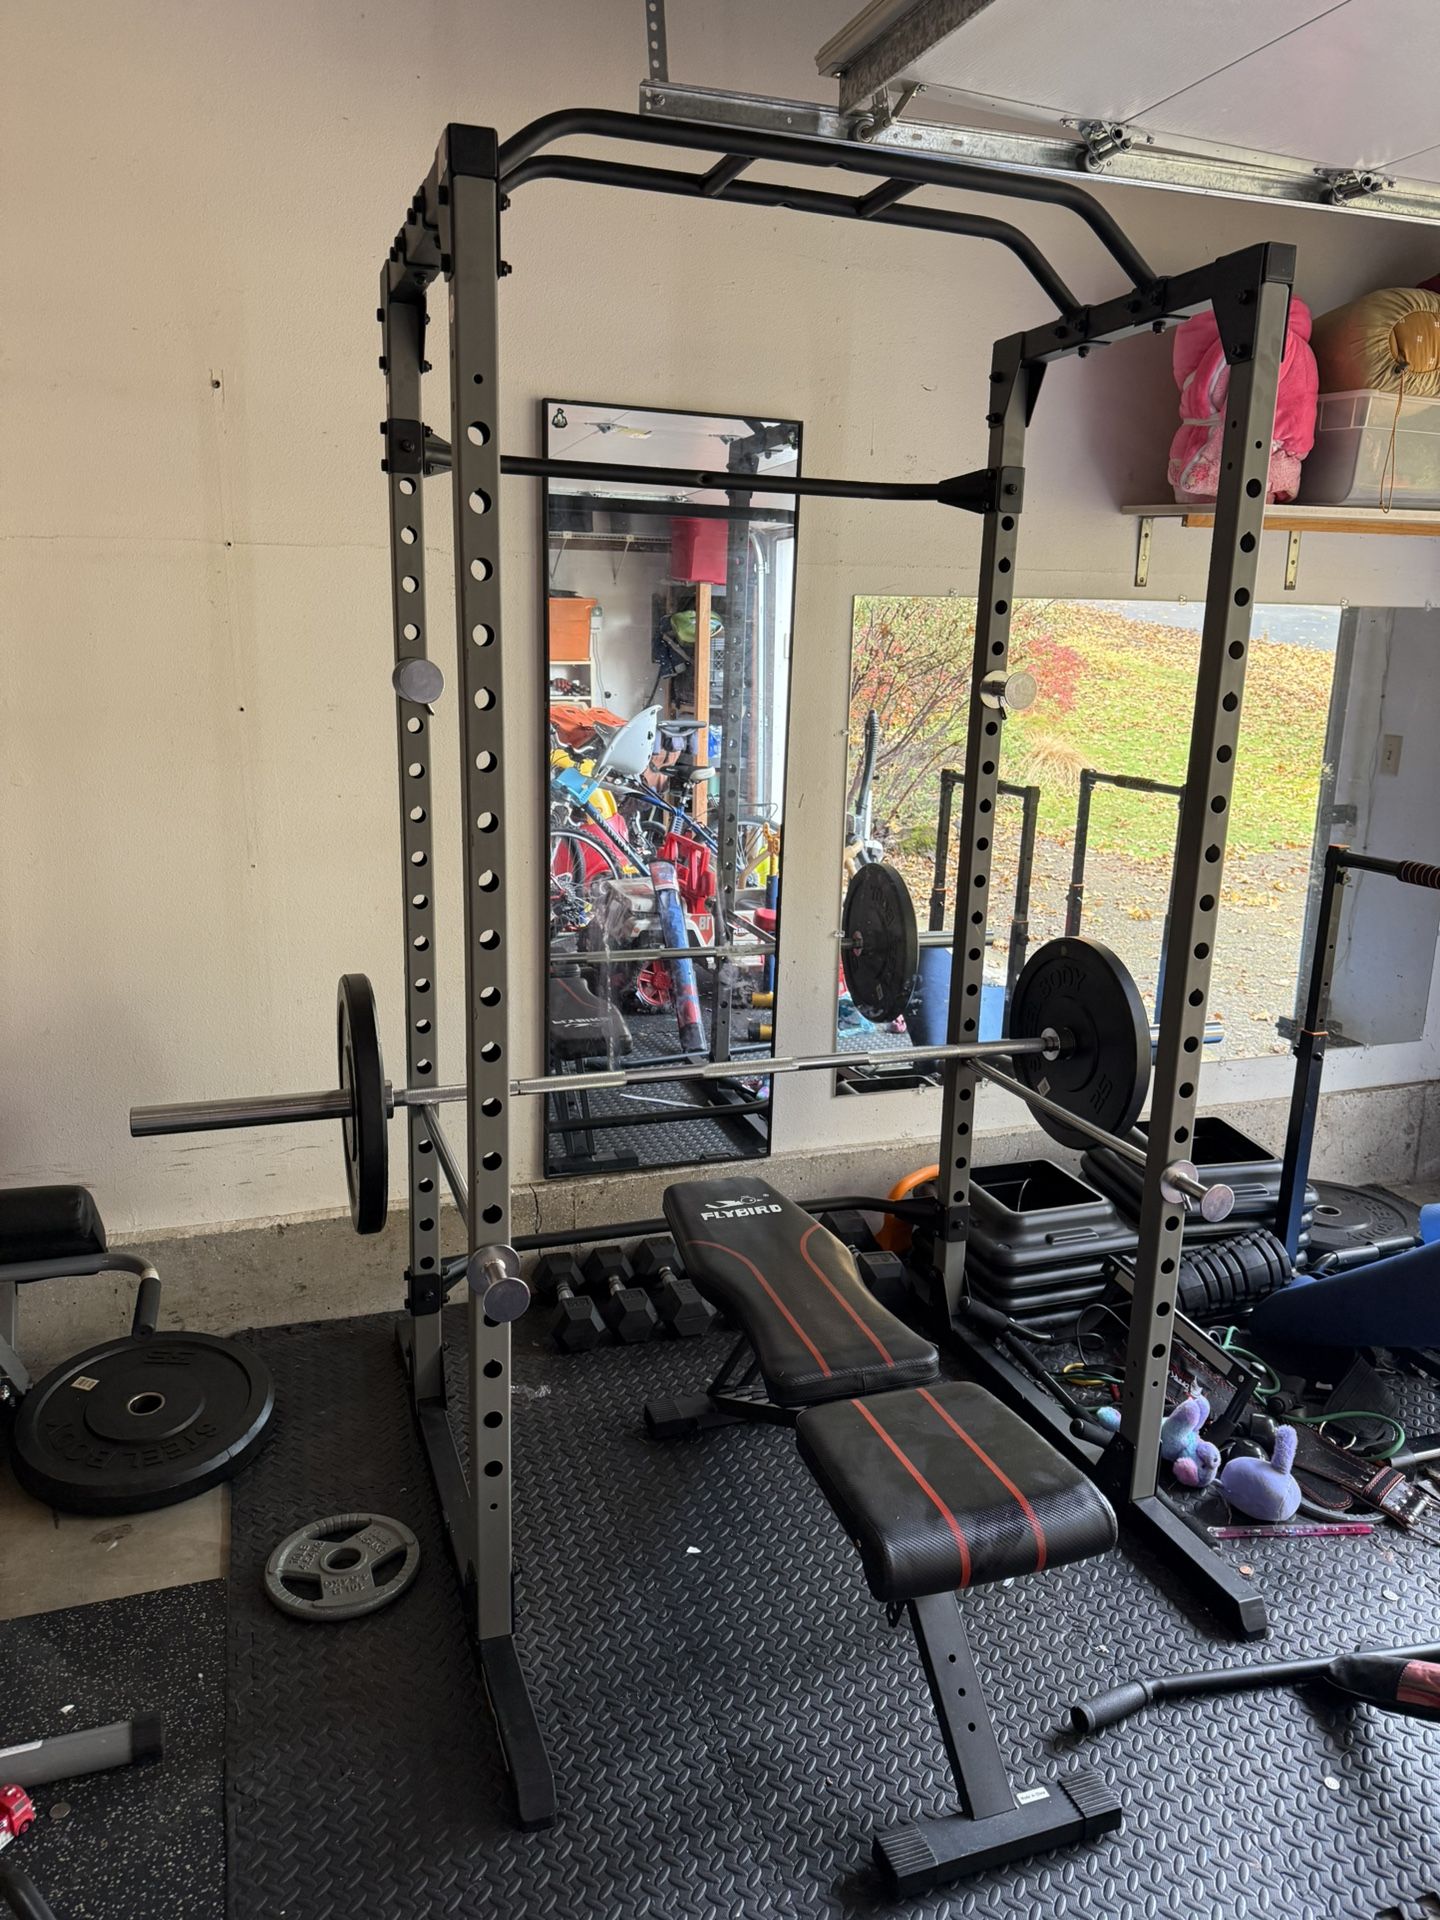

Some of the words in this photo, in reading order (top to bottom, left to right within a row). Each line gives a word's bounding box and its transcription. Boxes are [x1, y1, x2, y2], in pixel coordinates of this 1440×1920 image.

[1039, 965, 1087, 1000] BODY
[701, 1204, 783, 1220] FLYBIRD
[44, 1420, 121, 1471] BODY
[122, 1422, 218, 1470] STEEL
